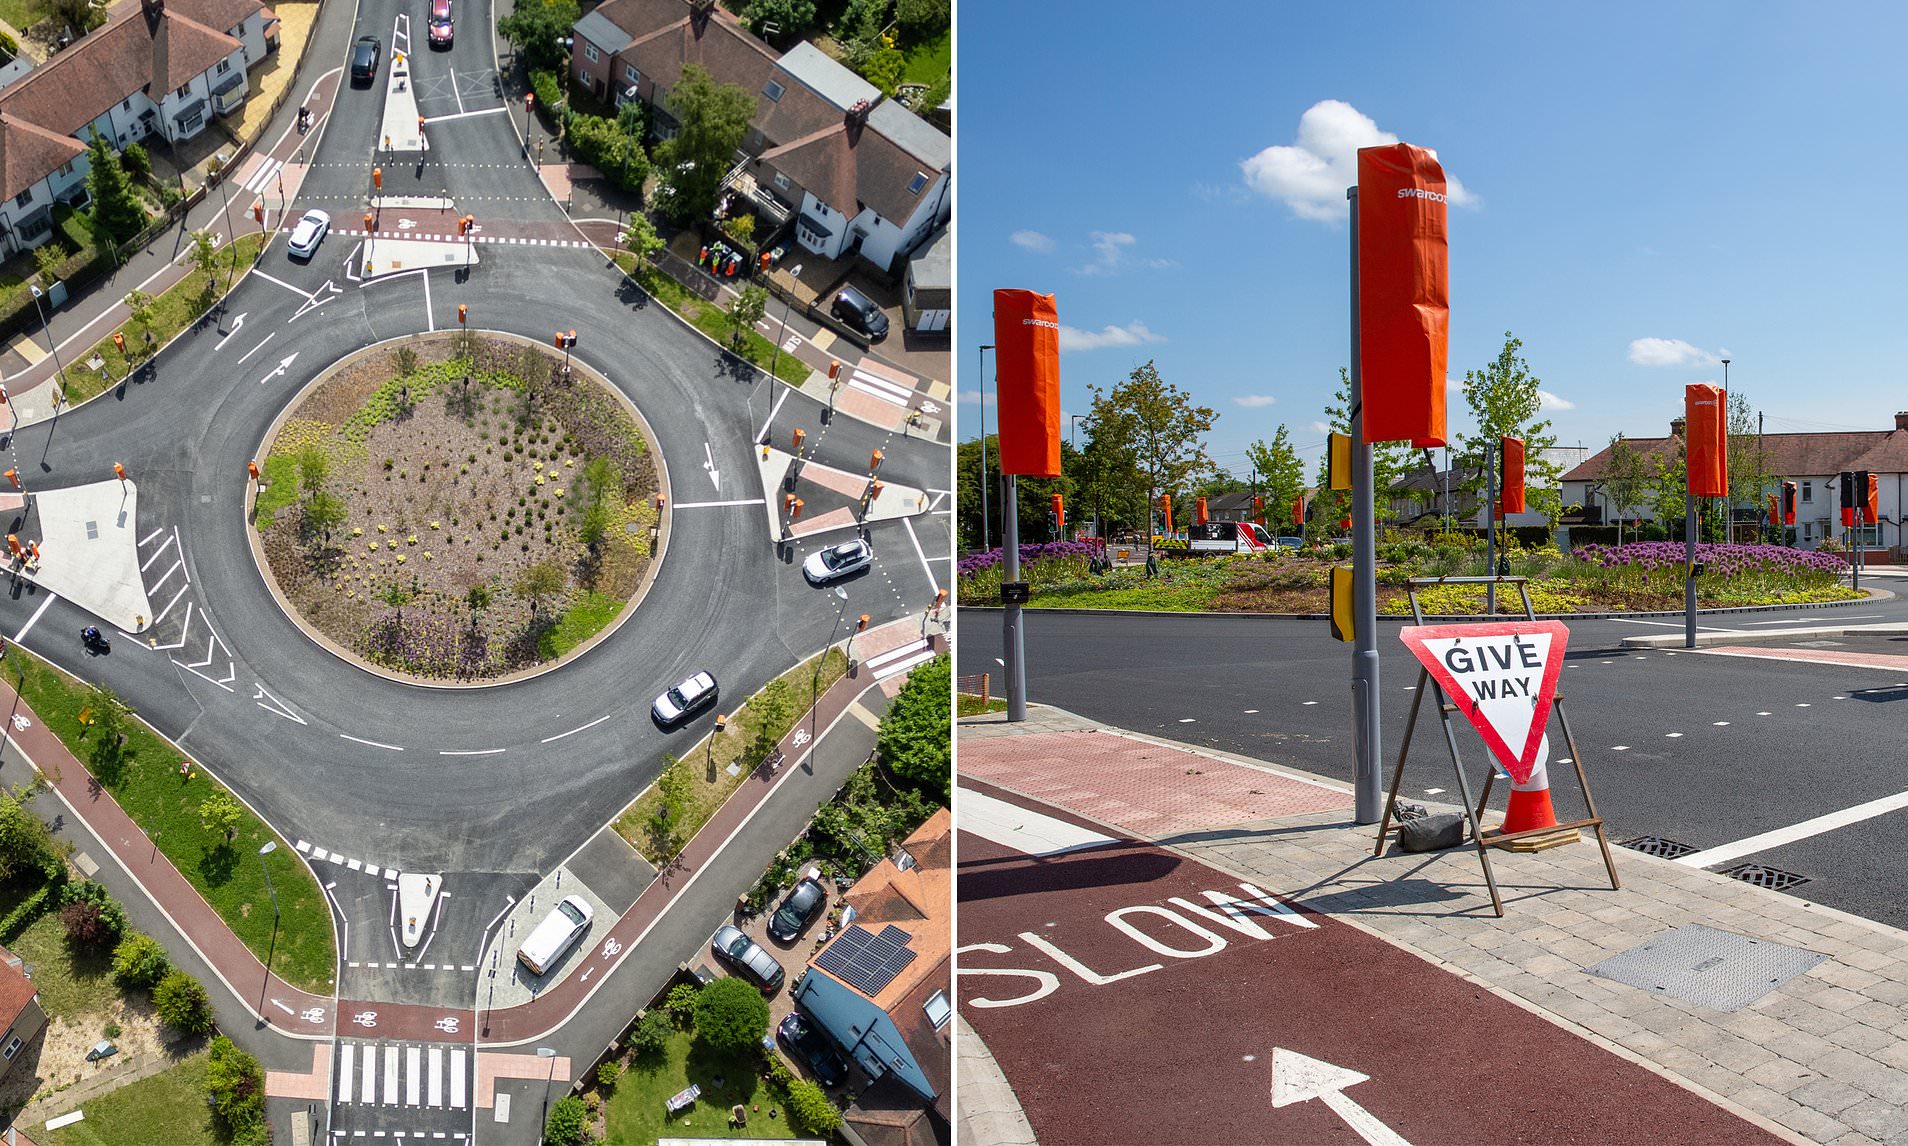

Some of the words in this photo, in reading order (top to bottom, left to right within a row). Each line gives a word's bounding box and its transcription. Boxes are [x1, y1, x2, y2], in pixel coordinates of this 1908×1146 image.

[1398, 187, 1443, 202] swarco
[1445, 643, 1542, 673] GIVE
[1472, 677, 1530, 700] WAY
[957, 882, 1321, 1008] SLOW
